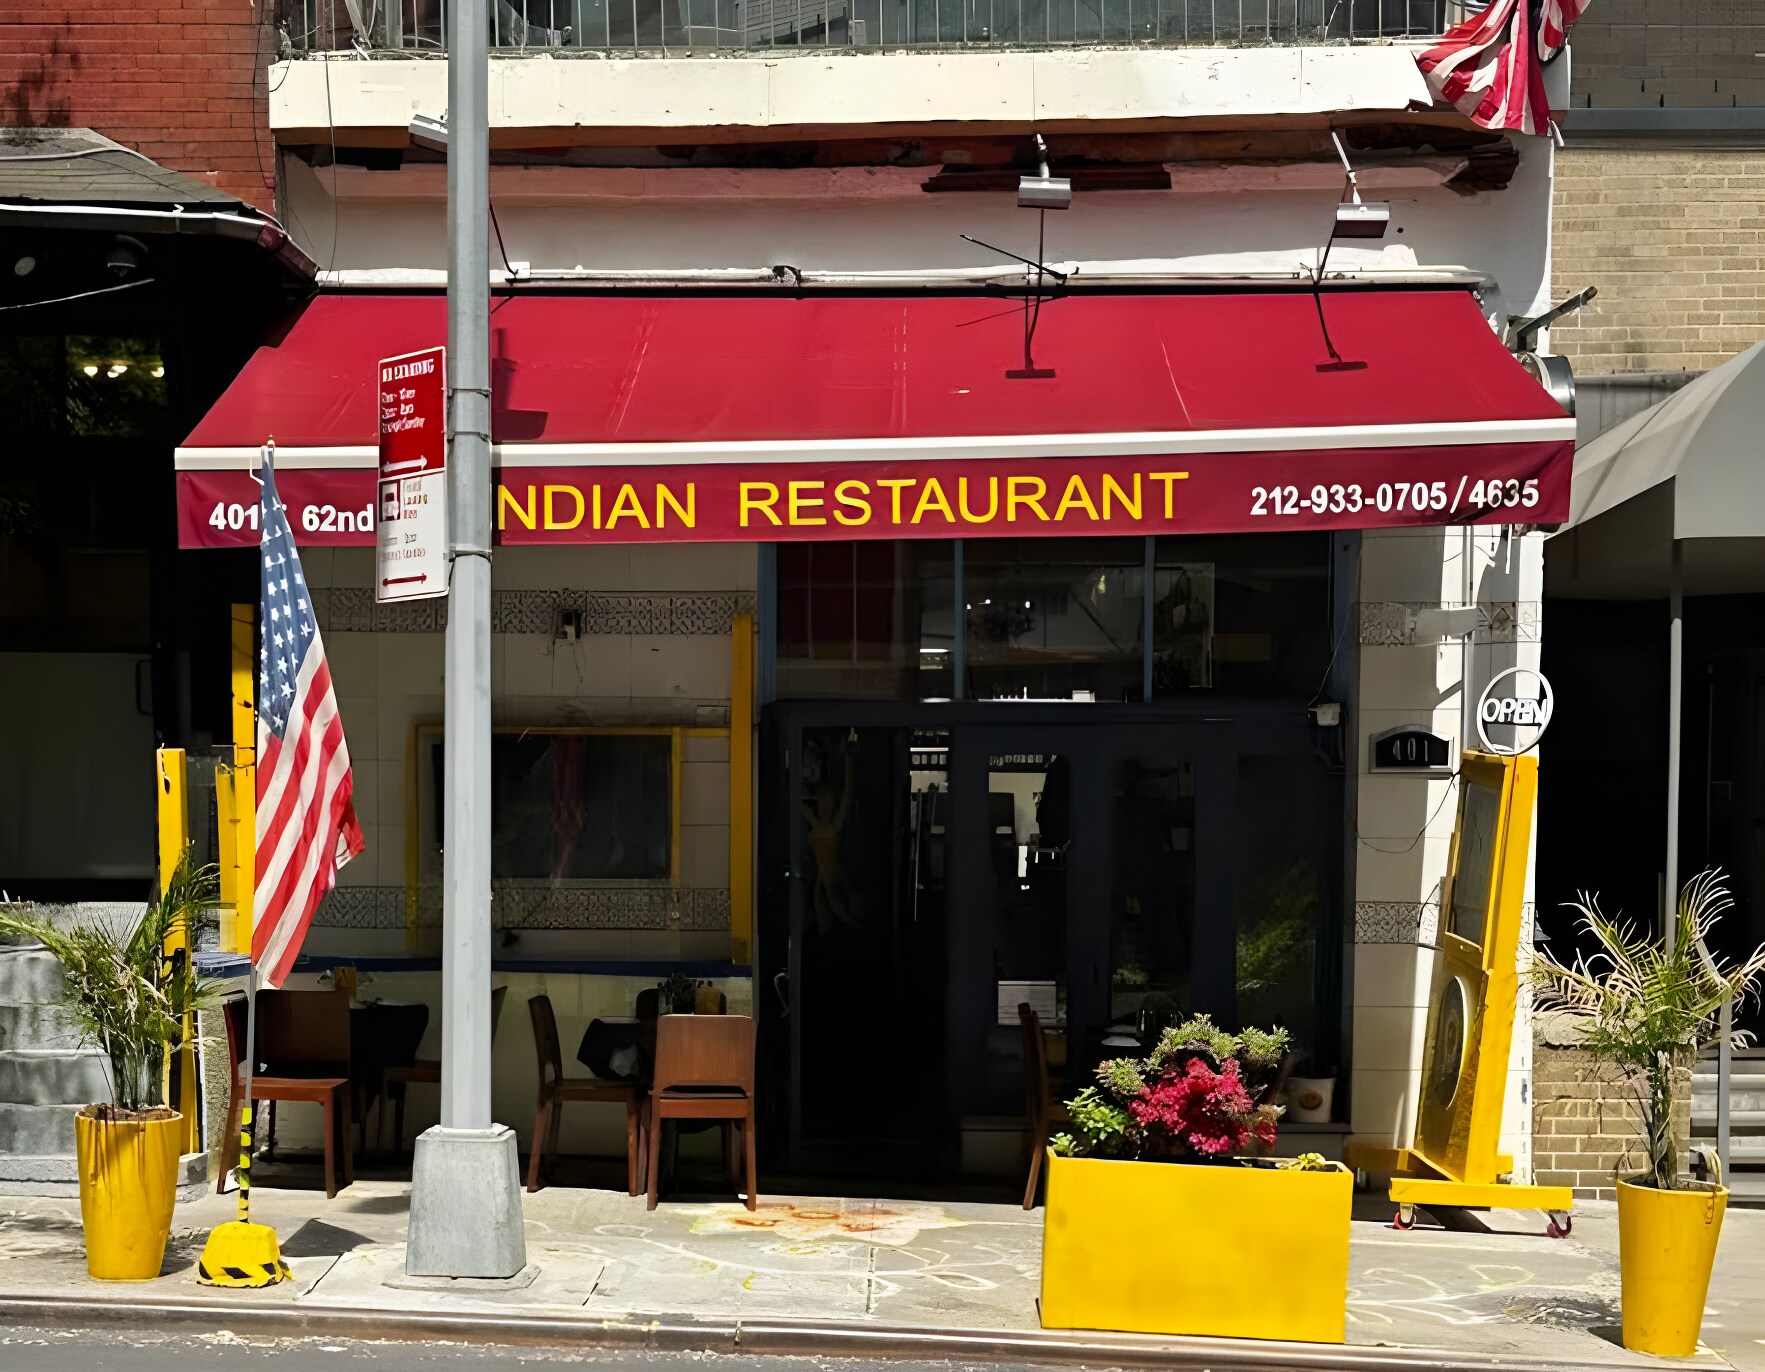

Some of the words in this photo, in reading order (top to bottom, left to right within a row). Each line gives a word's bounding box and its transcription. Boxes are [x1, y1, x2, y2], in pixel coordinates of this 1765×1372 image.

[497, 482, 696, 531] NDIAN
[738, 470, 1190, 528] RESTAURANT
[208, 501, 259, 530] 401
[302, 503, 374, 532] 62nd
[1482, 697, 1548, 724] OPEN
